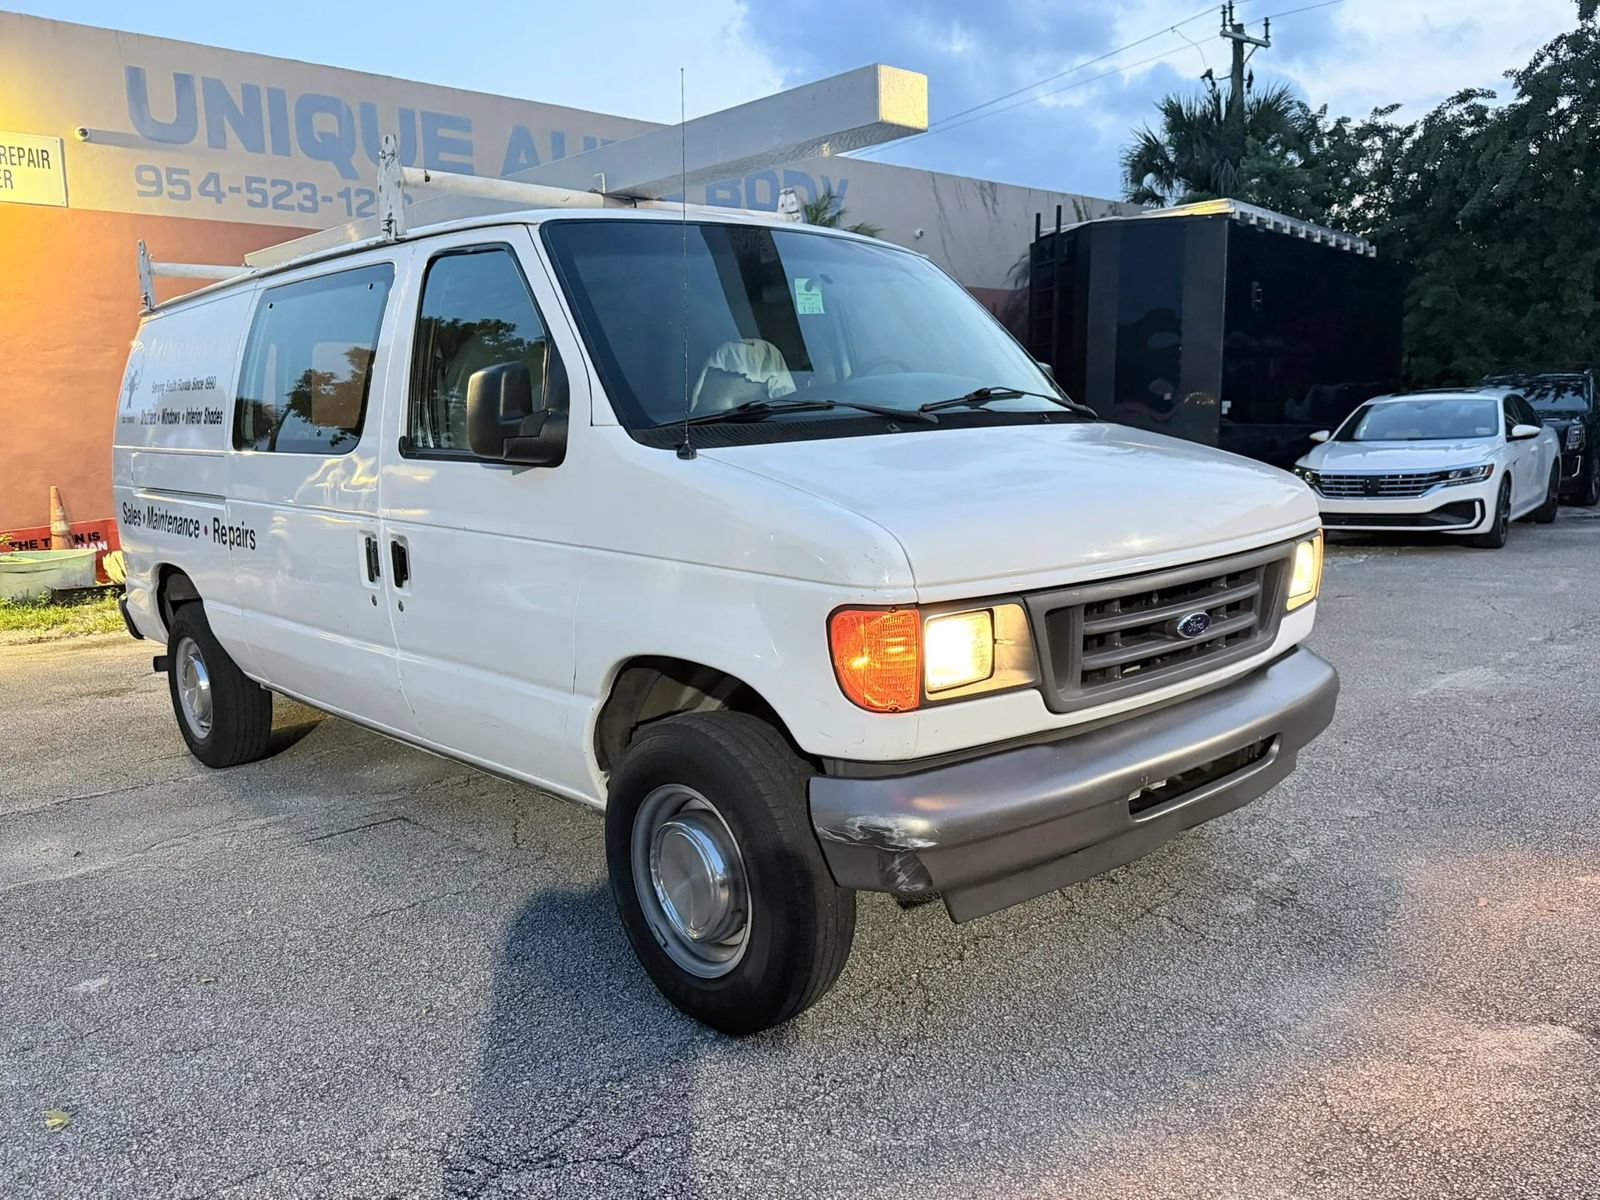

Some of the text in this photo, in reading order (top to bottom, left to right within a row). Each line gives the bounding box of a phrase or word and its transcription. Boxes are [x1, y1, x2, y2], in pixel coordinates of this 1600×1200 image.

[124, 65, 474, 180] UNIQUE
[0, 145, 51, 169] REPAIR
[135, 164, 413, 218] 954-523-12
[192, 376, 204, 390] Since
[161, 407, 180, 424] Windows
[185, 407, 203, 424] Interior
[203, 406, 223, 424] Shades
[88, 531, 101, 542] IS
[123, 502, 256, 551] Sales Maintenance Repairs
